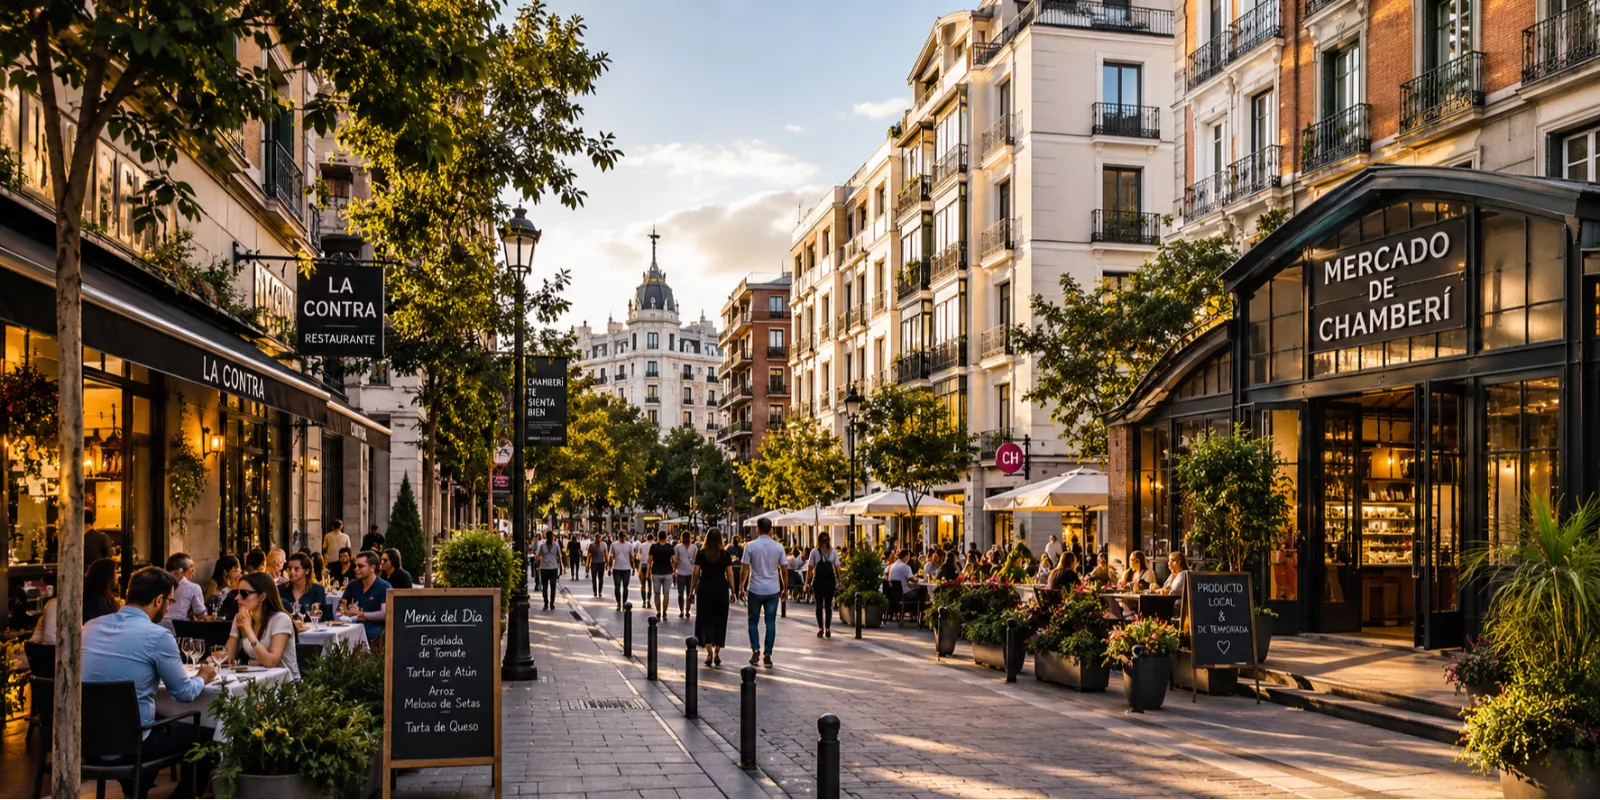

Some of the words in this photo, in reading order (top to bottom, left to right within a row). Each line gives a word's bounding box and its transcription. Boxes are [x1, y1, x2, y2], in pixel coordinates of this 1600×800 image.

[1324, 231, 1450, 285] MERCADO
[328, 276, 354, 294] LA
[1369, 276, 1394, 302] DE
[303, 300, 377, 318] CONTRA
[1319, 286, 1451, 342] CHAMBERÍ
[305, 333, 376, 345] RESTAURANTE
[203, 355, 219, 384] LA
[223, 364, 265, 400] CONTRA
[528, 387, 537, 397] TE
[527, 398, 556, 407] SIENTA
[527, 408, 546, 417] BIEN
[1002, 451, 1019, 465] CH
[1197, 583, 1243, 593] PRODUCTO
[1208, 597, 1235, 607] LOCAL
[404, 609, 436, 623] Menú
[440, 609, 457, 623] del
[1218, 610, 1226, 622] &
[1197, 625, 1207, 634] DE
[419, 648, 430, 658] de
[434, 647, 466, 658] Tomate
[406, 666, 436, 678] Tartar
[439, 666, 451, 677] de
[454, 666, 477, 677] Atún
[404, 698, 437, 709] Meloso
[440, 698, 451, 708] de
[455, 697, 481, 708] Setas
[405, 721, 430, 733] Tarta
[434, 721, 446, 732] de
[449, 720, 479, 733] Queso
